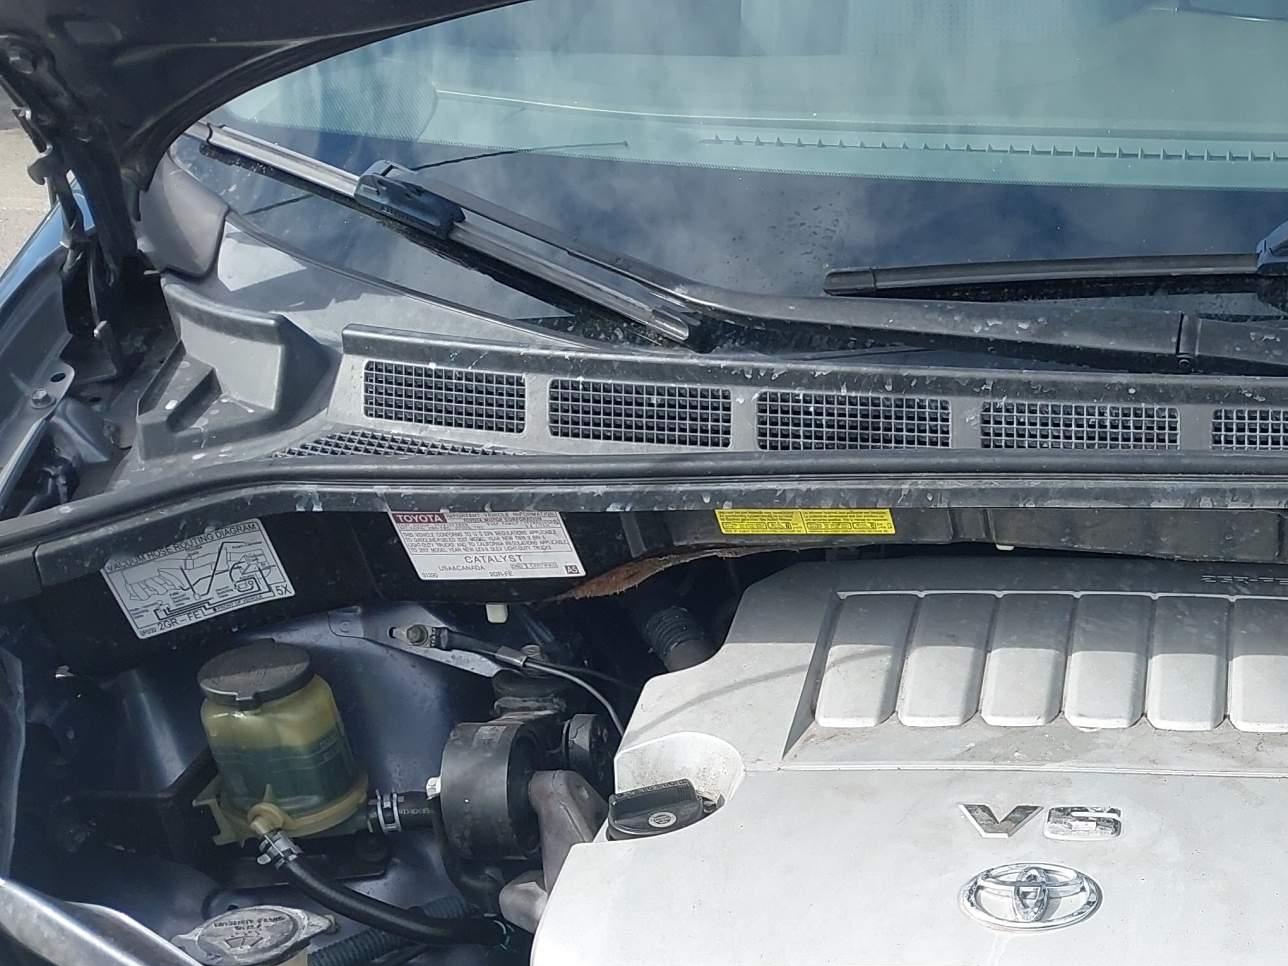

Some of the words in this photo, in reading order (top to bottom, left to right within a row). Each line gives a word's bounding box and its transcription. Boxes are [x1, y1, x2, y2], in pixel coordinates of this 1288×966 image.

[396, 514, 444, 523] TOYOTA
[145, 547, 170, 562] HOSE
[173, 534, 215, 552] ROUTING
[215, 523, 258, 539] DIAGRAM
[464, 554, 524, 564] CATALYST
[275, 583, 292, 597] 5X
[958, 803, 1123, 841] V6
